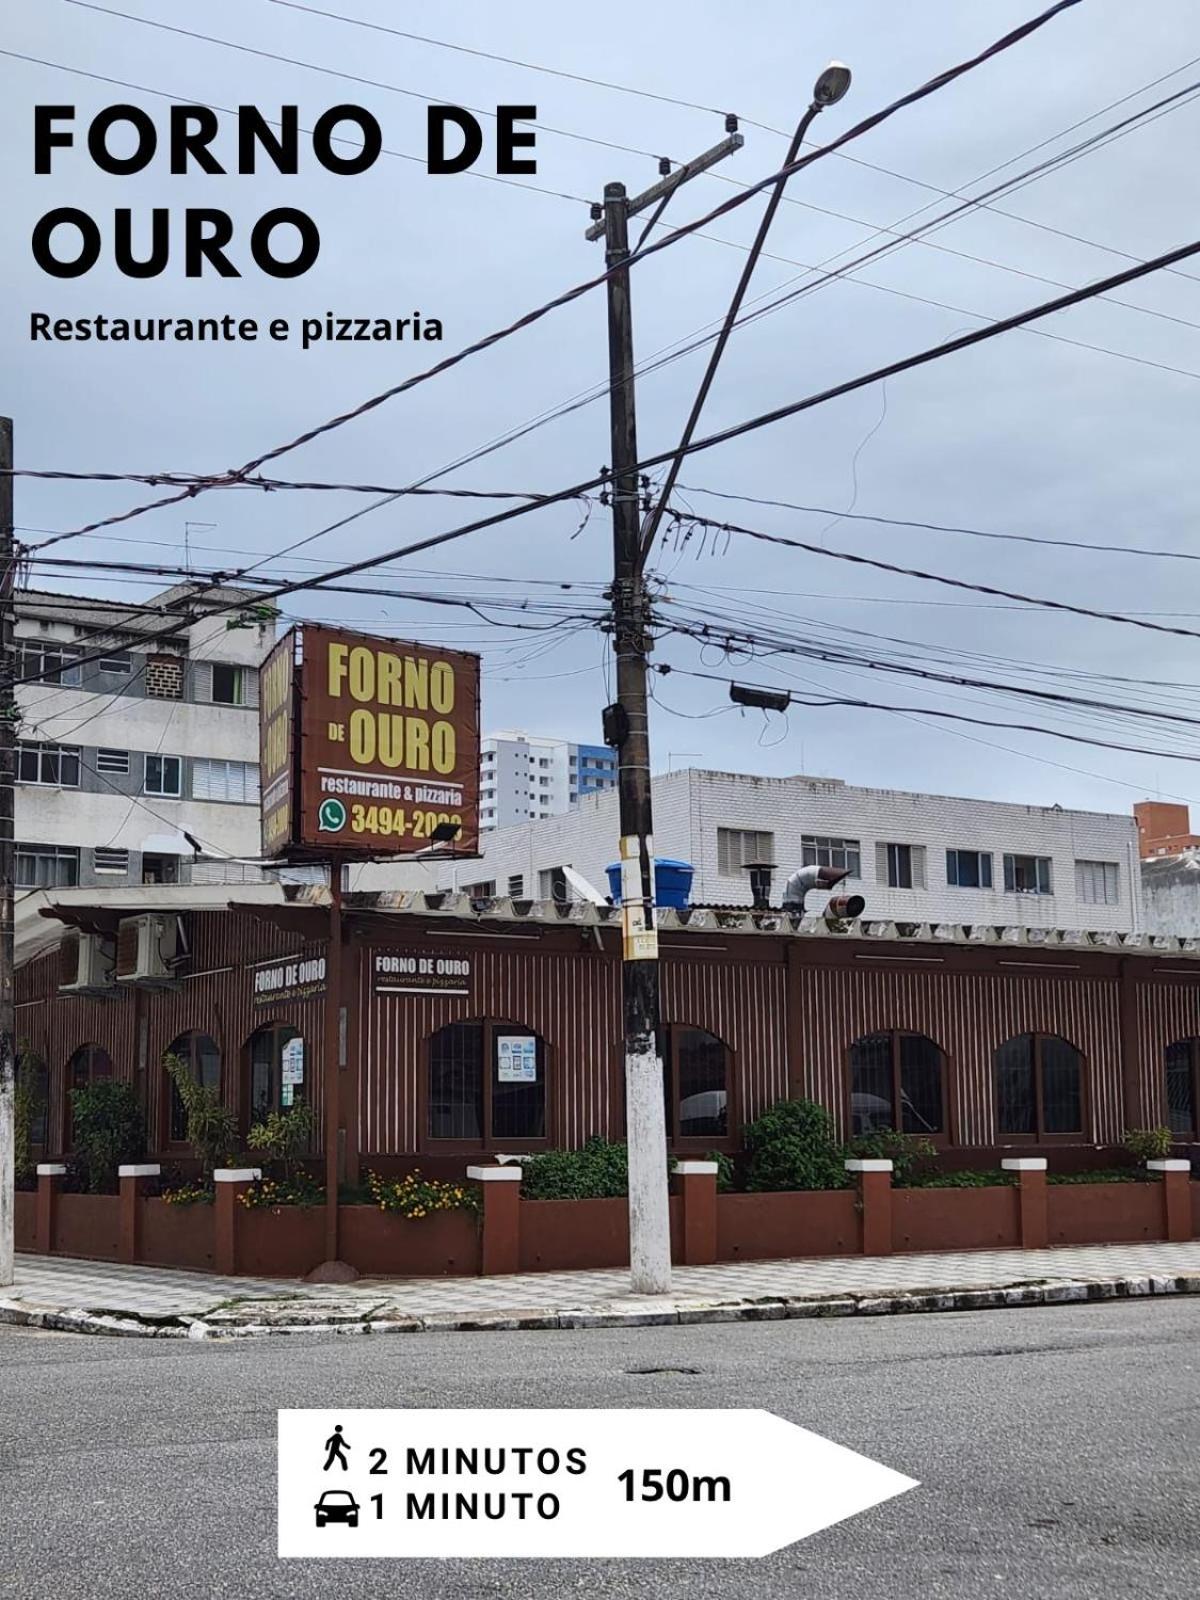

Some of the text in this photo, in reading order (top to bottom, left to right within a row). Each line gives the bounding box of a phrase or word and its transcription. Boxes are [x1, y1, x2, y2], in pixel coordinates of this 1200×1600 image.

[328, 642, 455, 715] FORNO
[328, 709, 456, 775] DE OURO
[321, 776, 462, 806] restaurante & pizzaria
[254, 958, 326, 993] FORNO DE OURO
[375, 956, 470, 976] FORNO DE OURO
